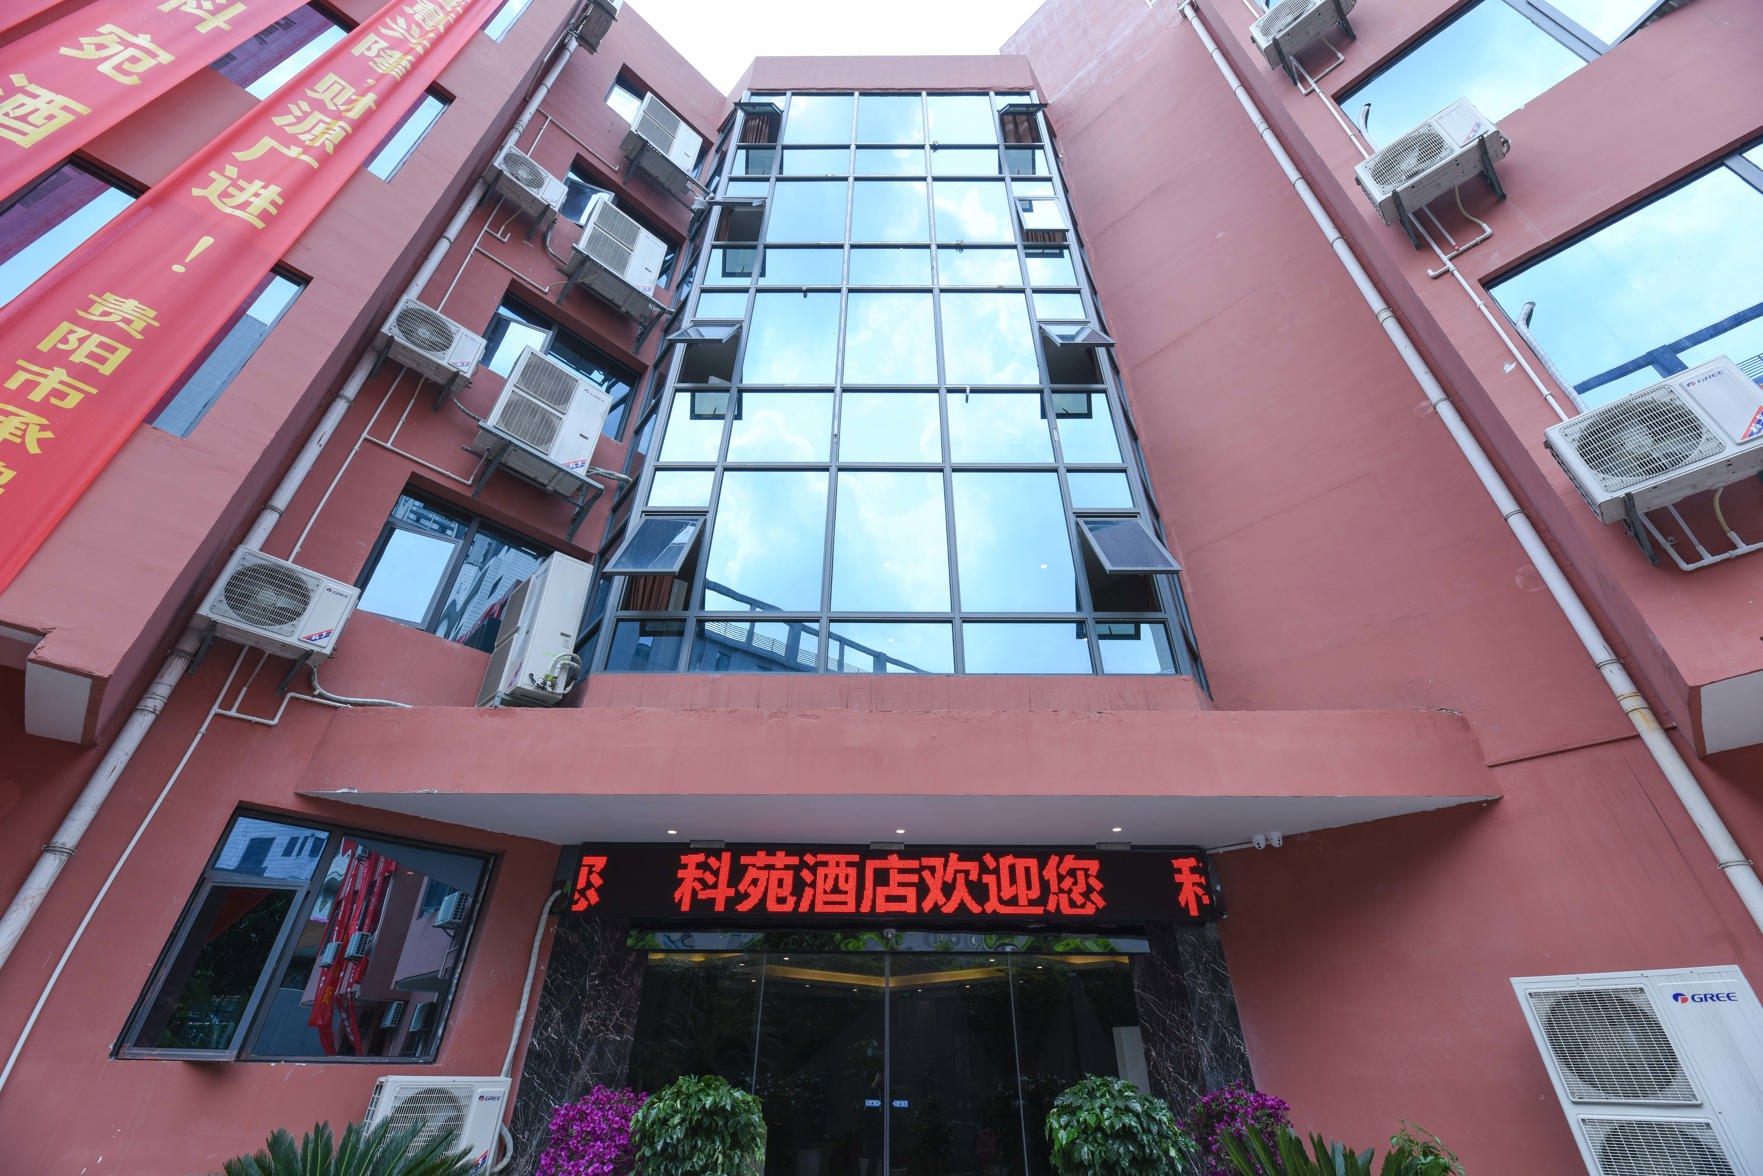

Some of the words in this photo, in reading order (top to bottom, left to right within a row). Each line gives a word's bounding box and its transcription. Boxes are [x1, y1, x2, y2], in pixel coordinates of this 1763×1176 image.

[673, 851, 1106, 915] 科苑酒店欢迎您
[1691, 992, 1738, 1003] GREE
